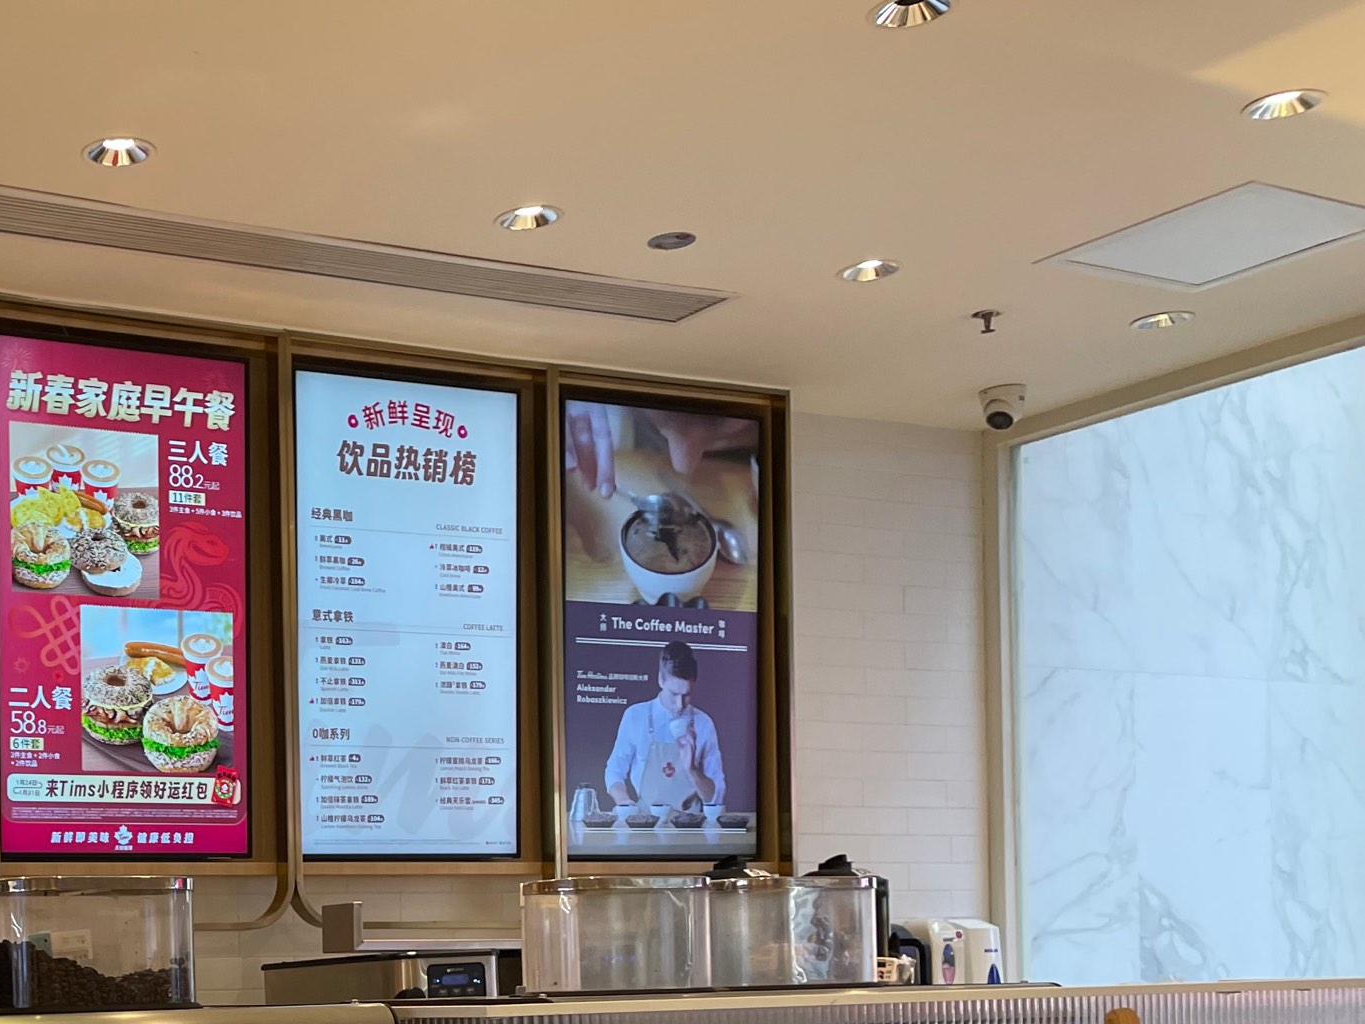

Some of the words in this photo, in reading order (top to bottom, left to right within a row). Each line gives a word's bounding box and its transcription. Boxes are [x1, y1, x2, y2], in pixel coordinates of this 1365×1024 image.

[6, 369, 235, 432] 新春家庭早午餐
[362, 400, 455, 438] 新鲜呈现
[168, 440, 228, 466] 三人餐
[337, 440, 476, 486] 饮品热销榜
[436, 523, 459, 531] CLASSIC
[461, 525, 480, 533] BLACK
[312, 609, 354, 622] 意式拿铁
[612, 617, 632, 630] The
[635, 618, 672, 632] Coffee
[675, 621, 714, 634] Master
[9, 685, 72, 710] 二人餐
[10, 710, 64, 735] 58.8元起
[312, 728, 350, 740] 0咖系列
[12, 738, 40, 749] 6件套
[45, 779, 208, 800] 来Tims小程序领好运红包
